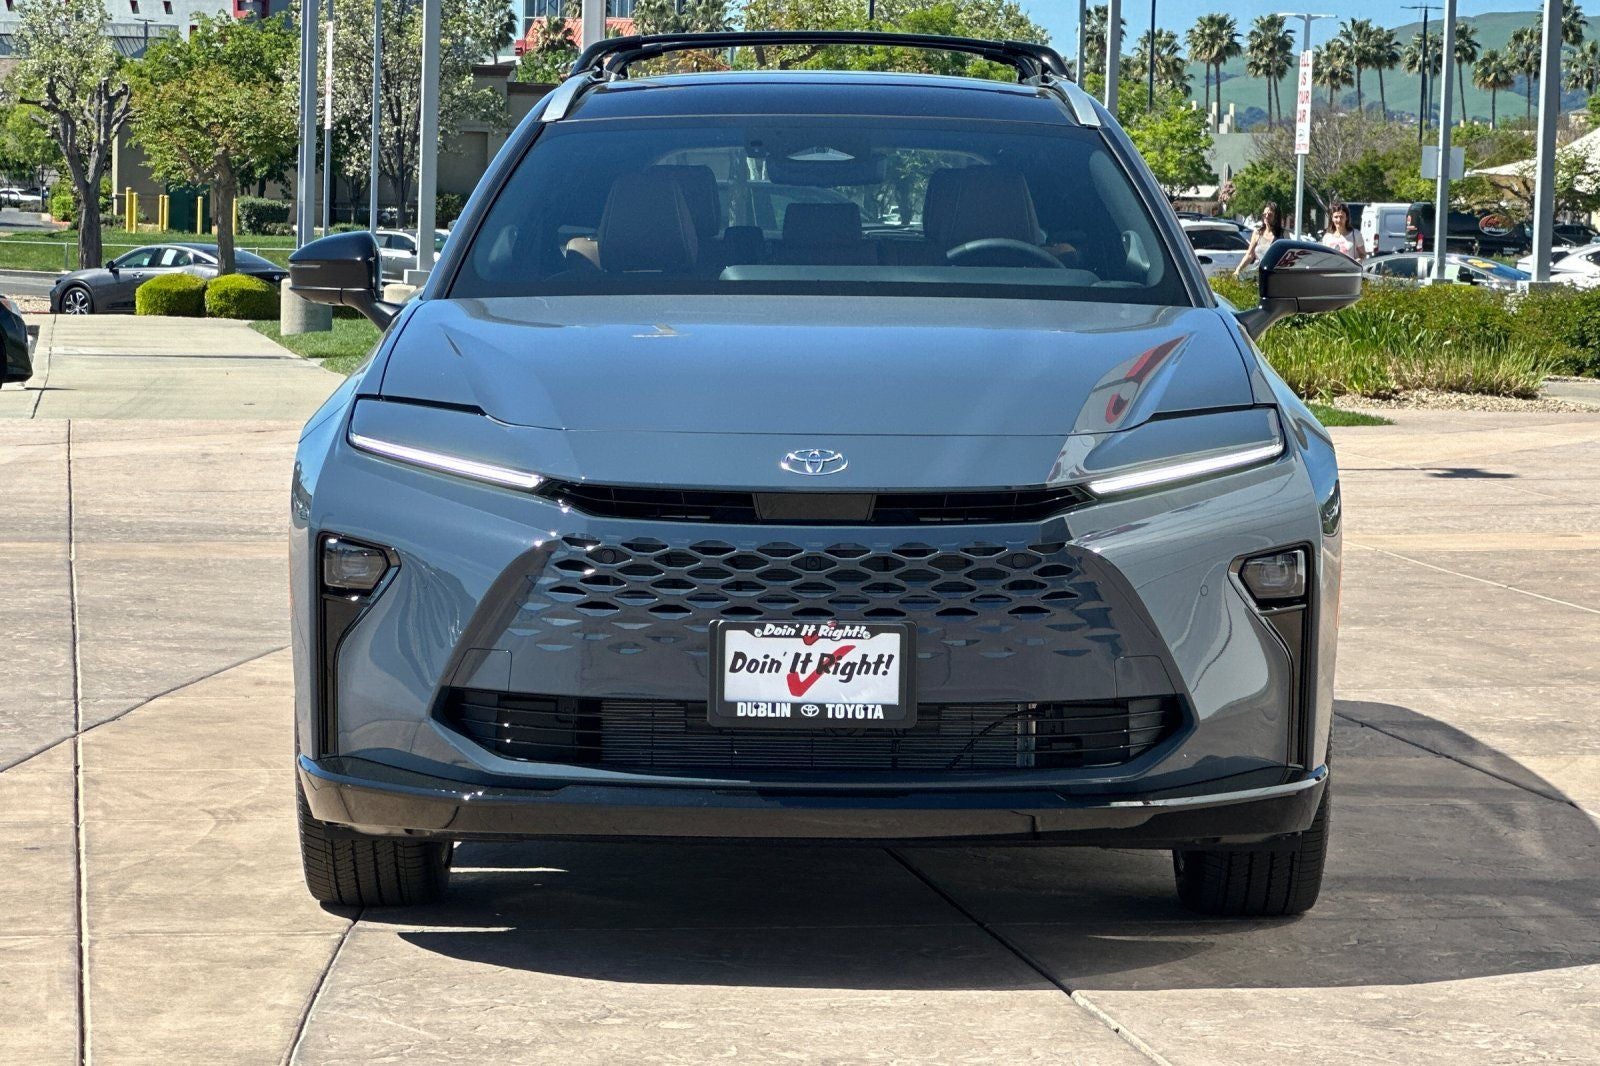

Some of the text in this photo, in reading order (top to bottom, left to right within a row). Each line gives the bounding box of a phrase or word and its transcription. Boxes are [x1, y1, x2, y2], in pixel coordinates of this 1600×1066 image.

[763, 623, 867, 641] Doin' It Right!
[729, 651, 895, 684] Doin' It Right!
[736, 701, 884, 719] DUBLIN TOYOTA
